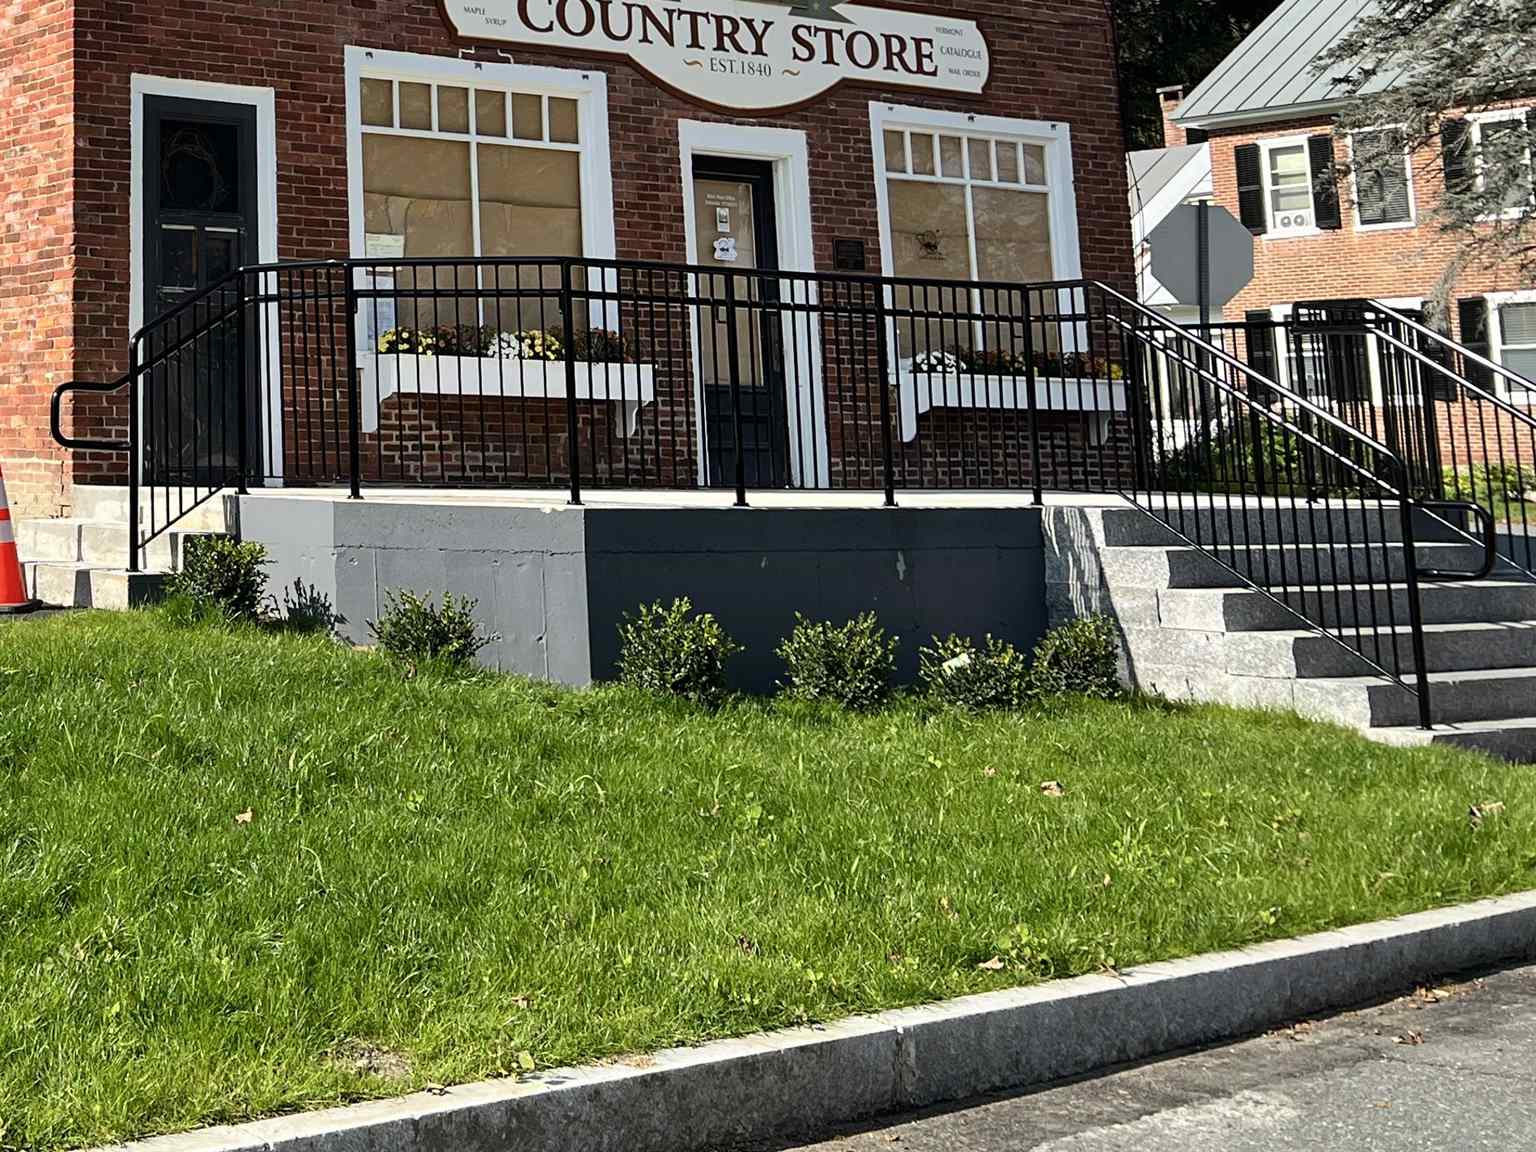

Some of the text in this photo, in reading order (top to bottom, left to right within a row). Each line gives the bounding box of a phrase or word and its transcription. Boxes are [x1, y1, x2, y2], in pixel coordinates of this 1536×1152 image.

[464, 6, 485, 15] MAPLE
[484, 17, 507, 26] SYRUP
[791, 23, 939, 78] STORE
[940, 46, 982, 60] CATALOGUE
